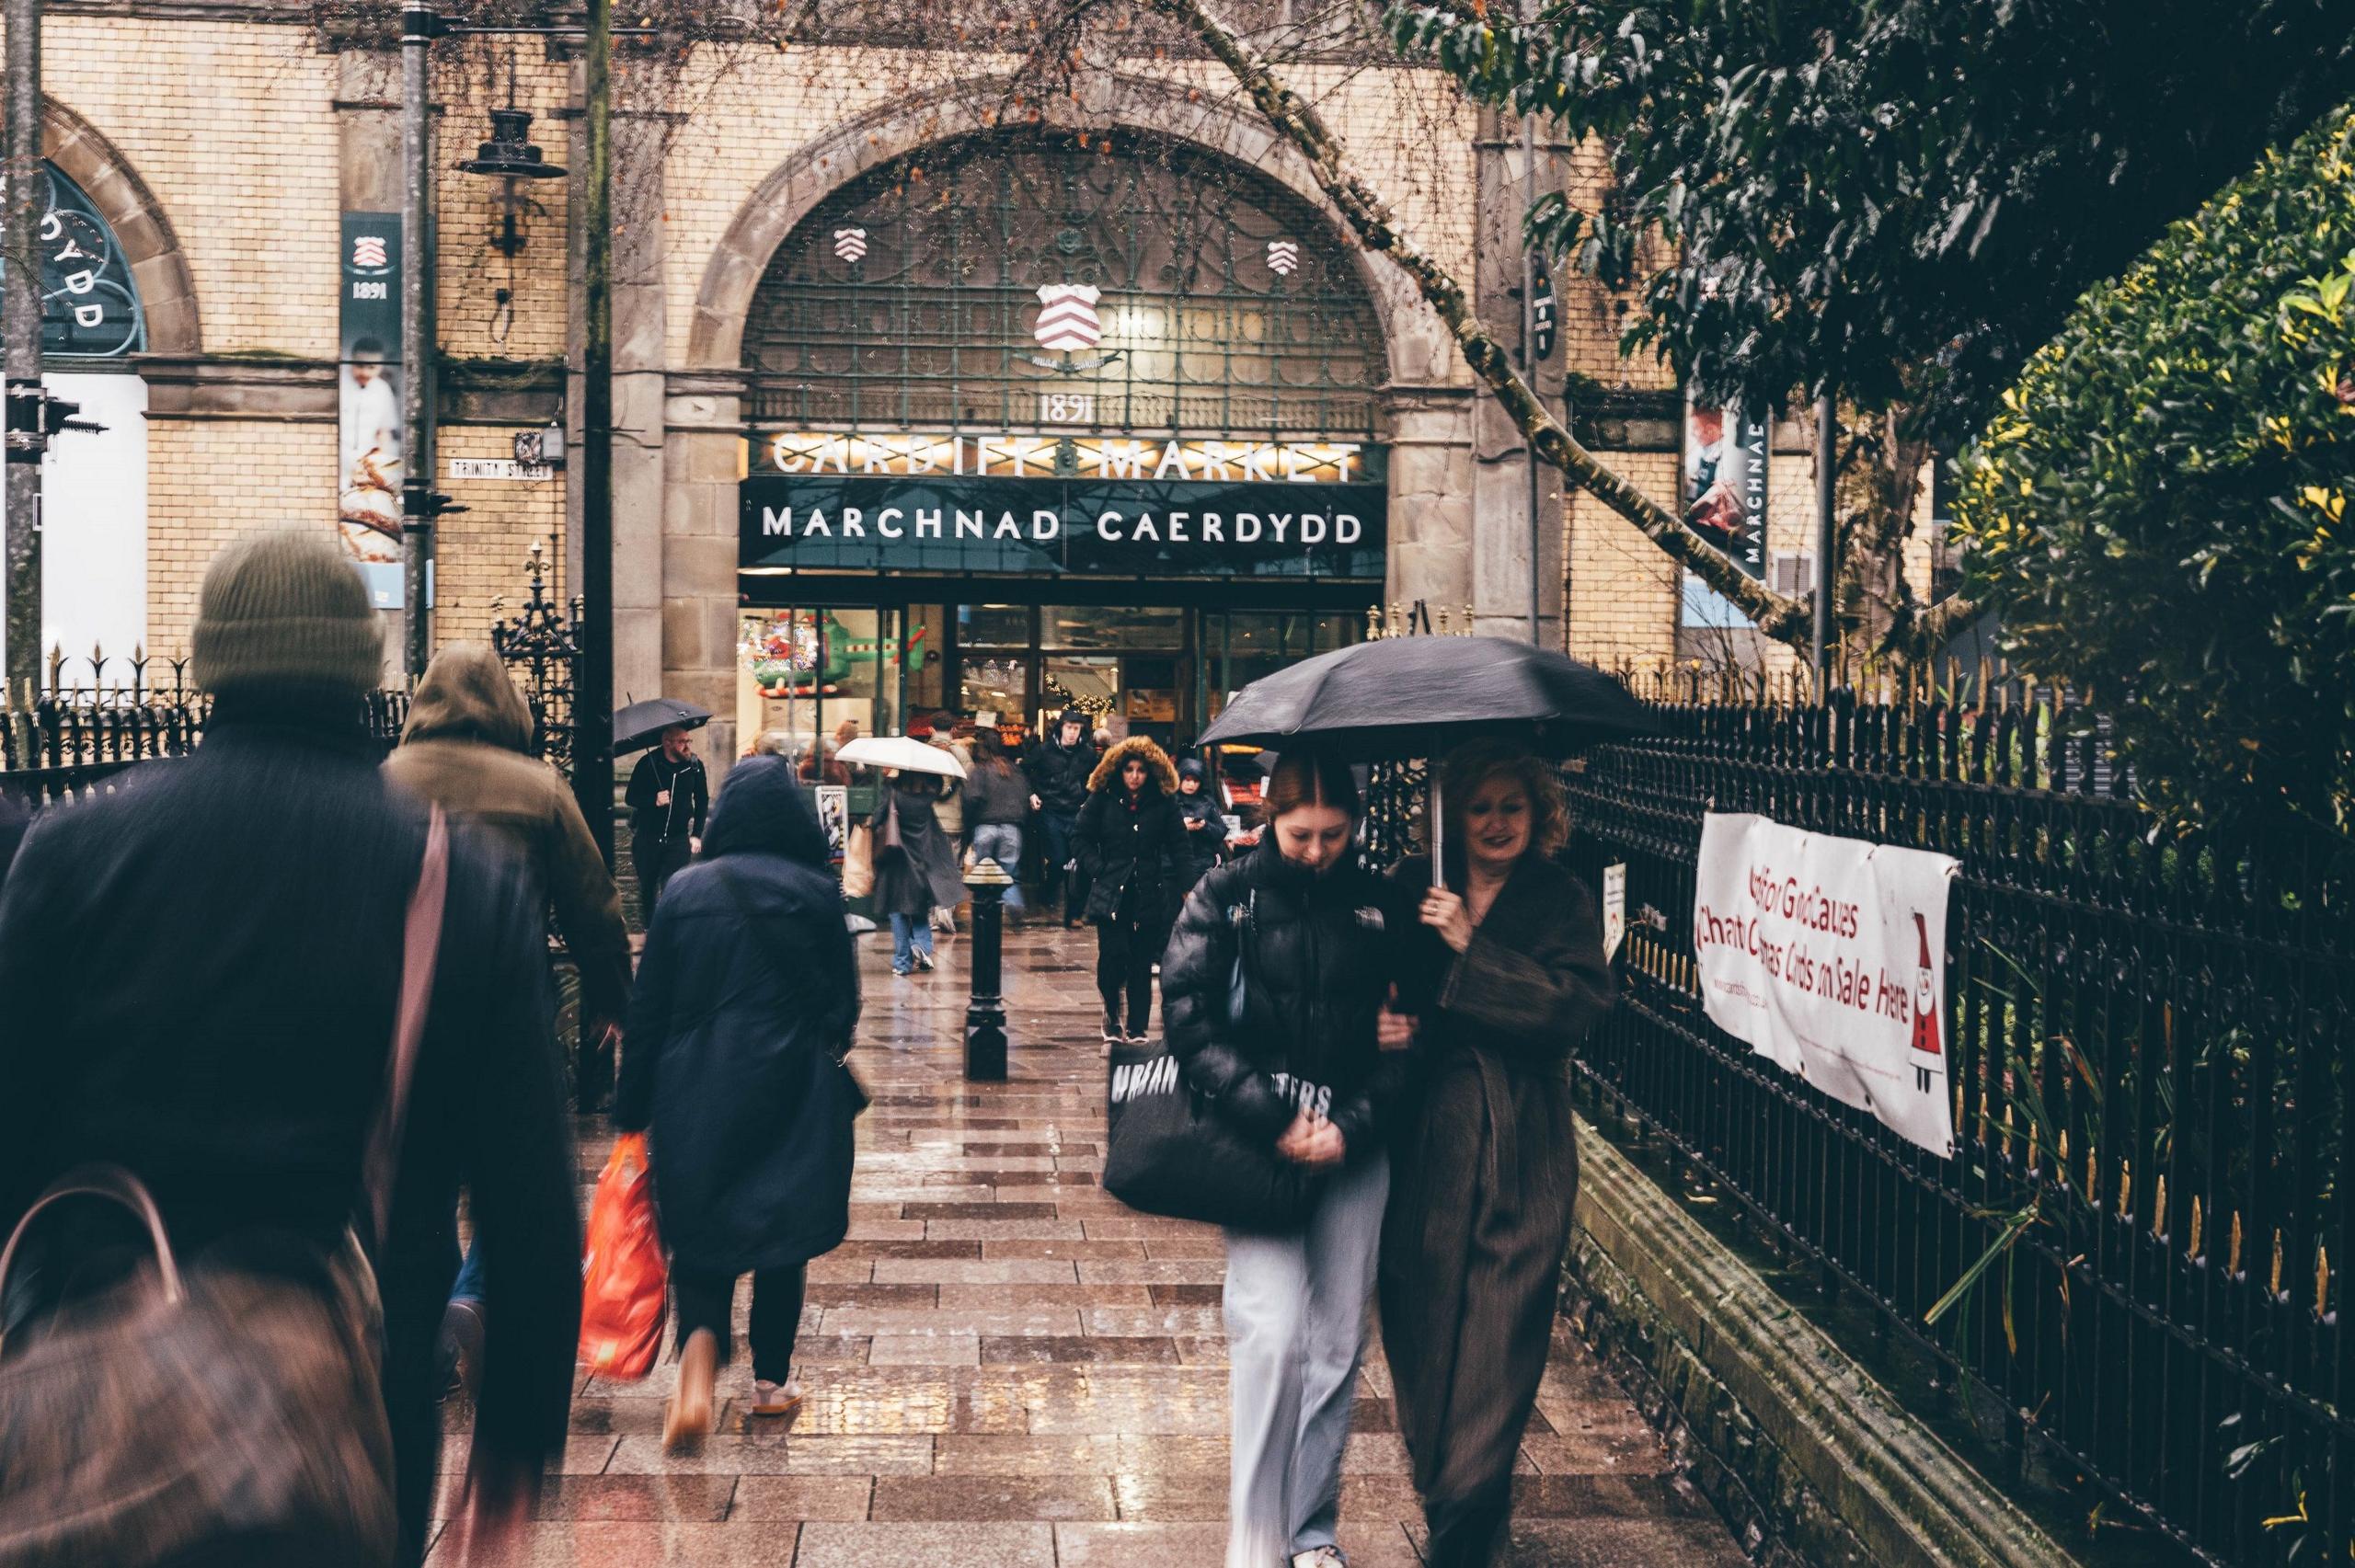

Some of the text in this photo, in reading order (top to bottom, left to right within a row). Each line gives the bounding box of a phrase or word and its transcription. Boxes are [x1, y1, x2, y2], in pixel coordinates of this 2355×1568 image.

[352, 280, 387, 300] 1891
[1040, 394, 1094, 422] 1891
[454, 462, 550, 477] TRINITY STREET
[773, 433, 1361, 483] CARDIFF MARKET
[762, 506, 1361, 544] MARCHNAD CAERDYDD
[1836, 956, 1870, 1010] Sale
